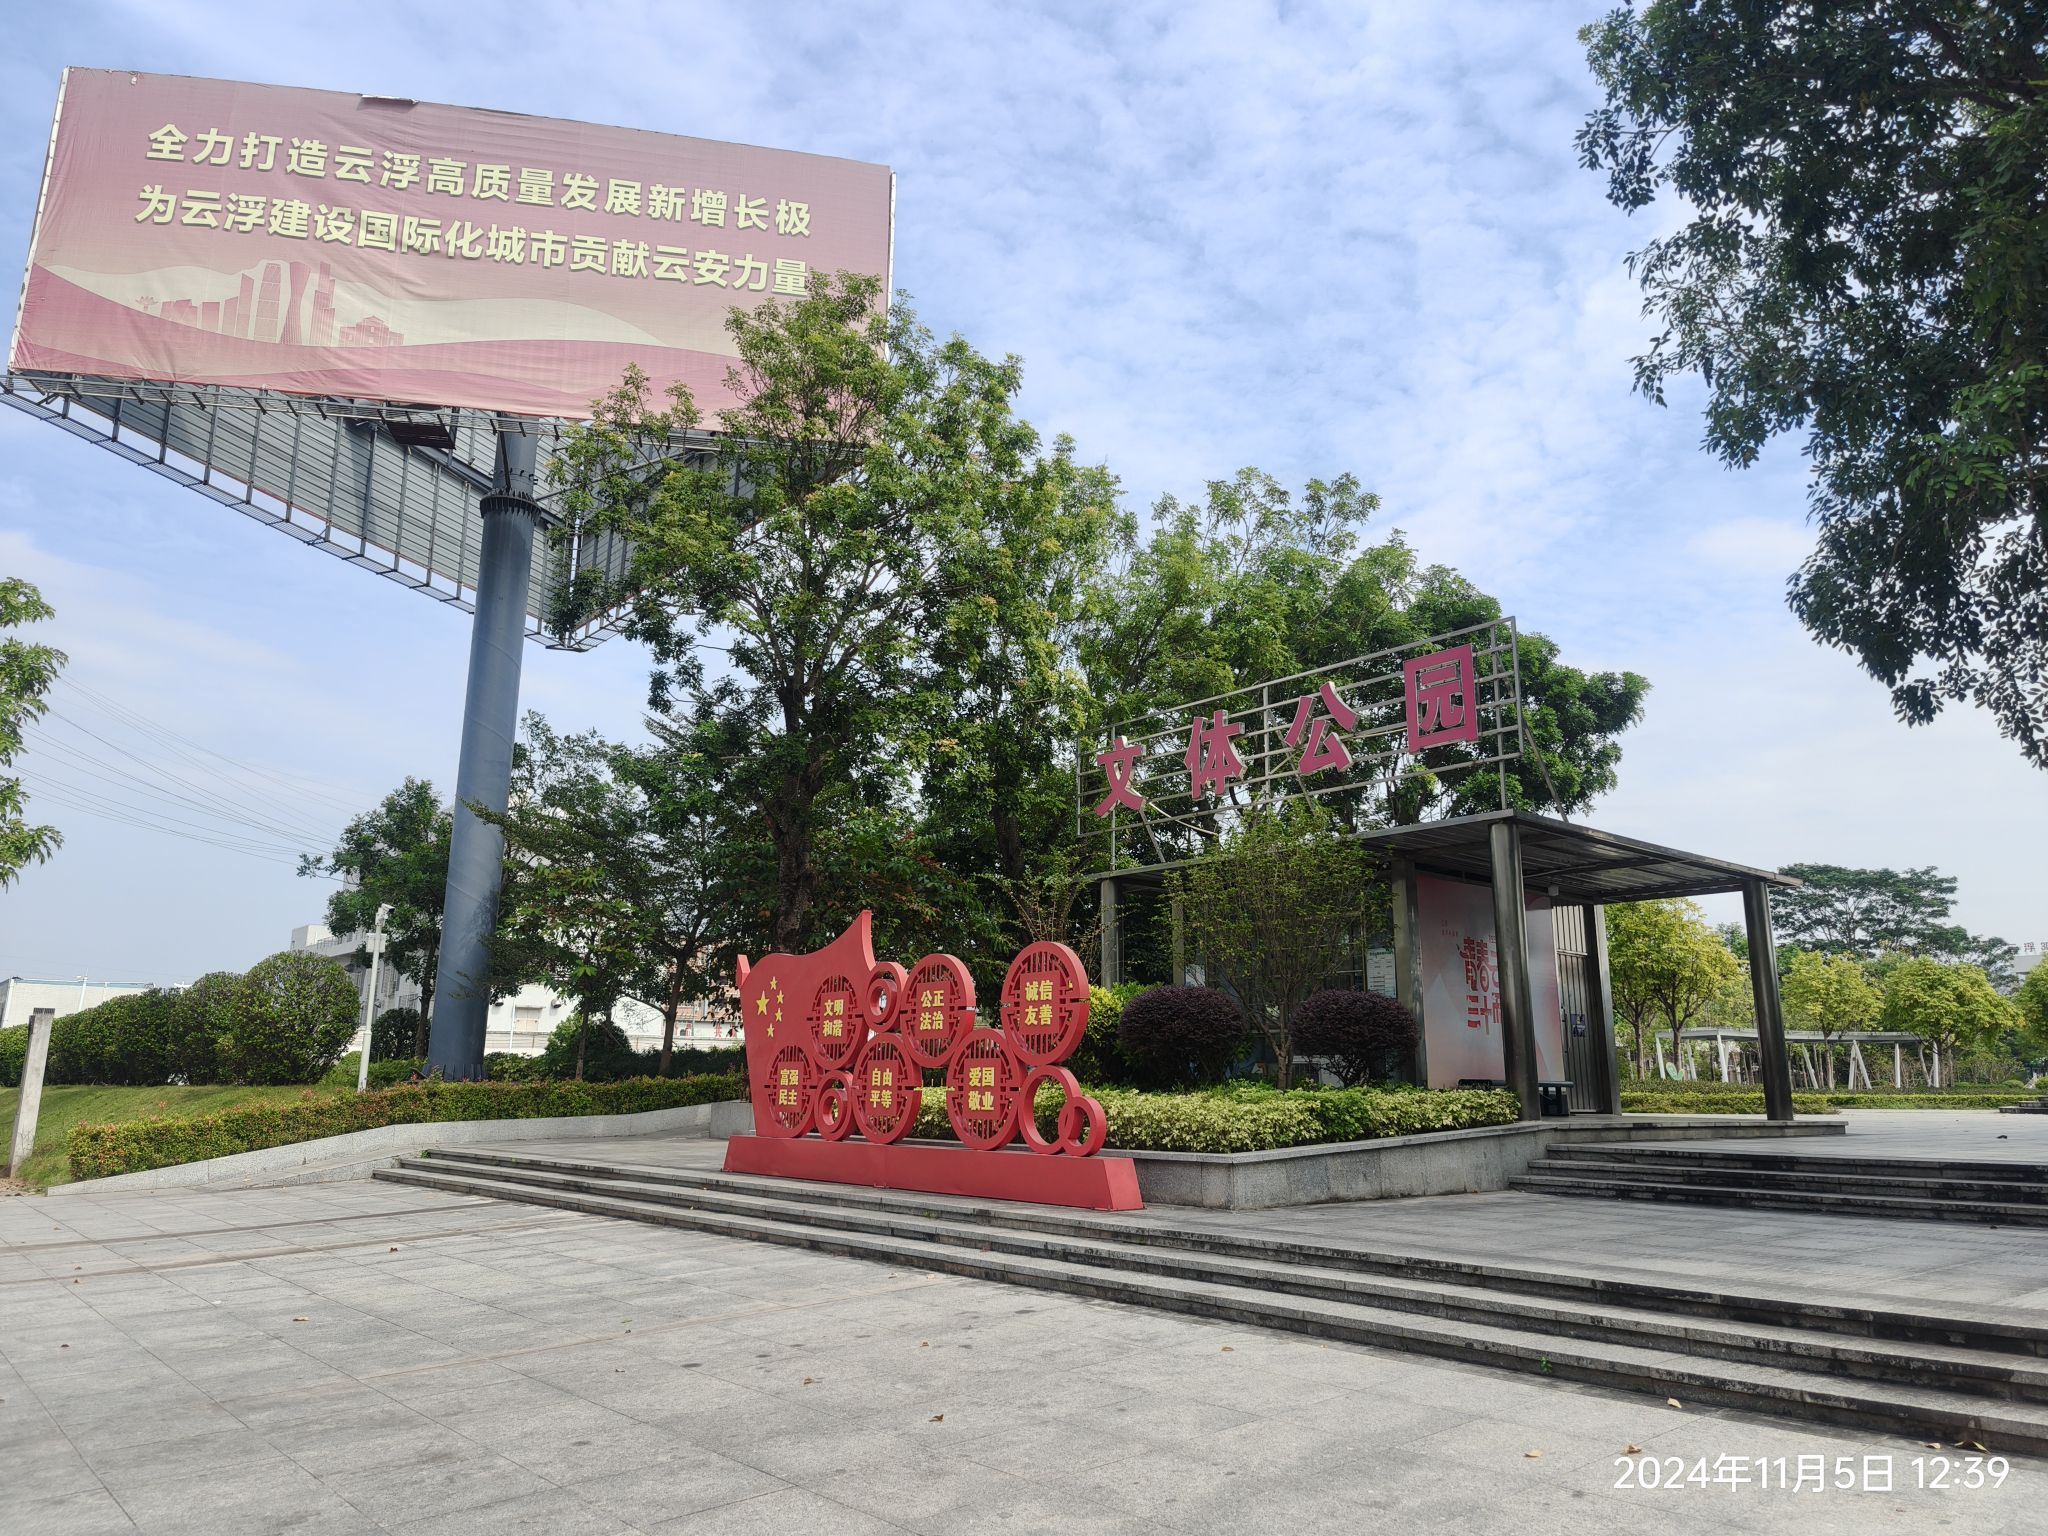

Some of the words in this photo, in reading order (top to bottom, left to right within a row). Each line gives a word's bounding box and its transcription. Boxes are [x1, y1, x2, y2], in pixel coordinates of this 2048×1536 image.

[146, 123, 811, 236] 全力打造云浮高质量发展新增长极
[134, 184, 809, 296] 为云浮建设国际化城市贡献云安力量
[1094, 643, 1479, 818] 文体公园
[920, 989, 945, 1008] 公正
[1024, 979, 1053, 1002] 诚信
[823, 999, 844, 1017] 文明
[1024, 1003, 1053, 1026] 友善
[822, 1019, 843, 1037] 和谐
[919, 1010, 944, 1031] 法治
[780, 1068, 799, 1086] 富强
[871, 1067, 893, 1087] 自由
[968, 1066, 995, 1087] 爱国
[778, 1088, 797, 1106] 民主
[869, 1089, 892, 1109] 平等
[967, 1090, 994, 1111] 敬业
